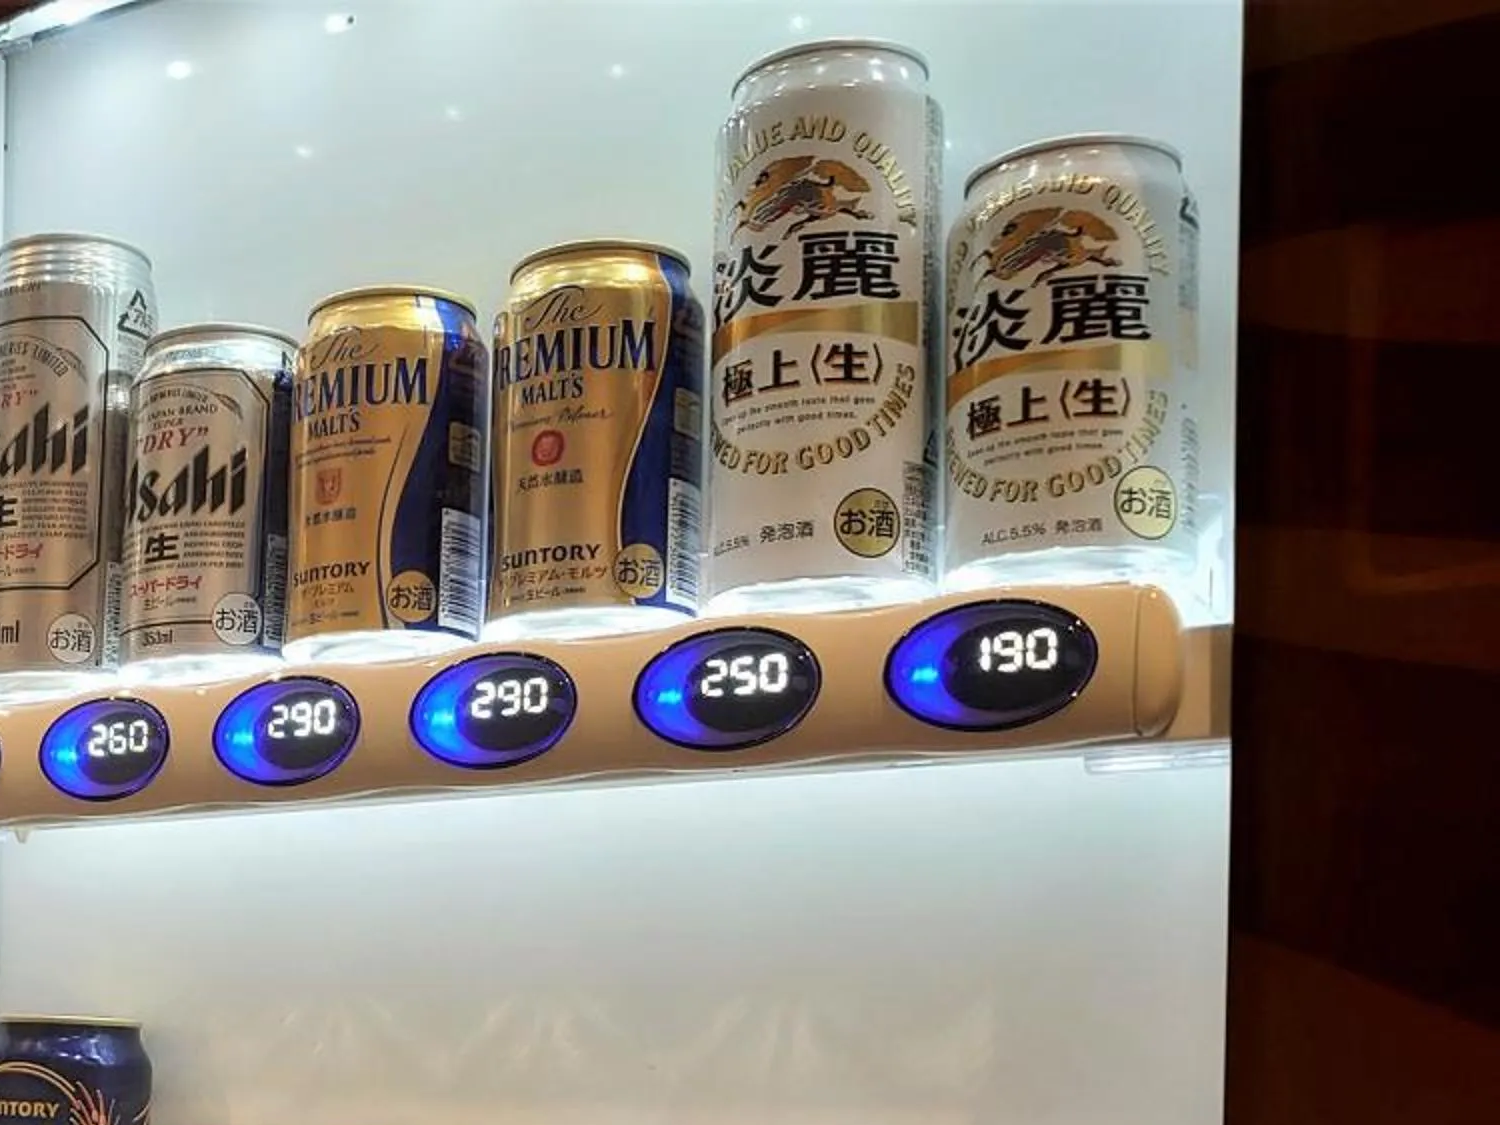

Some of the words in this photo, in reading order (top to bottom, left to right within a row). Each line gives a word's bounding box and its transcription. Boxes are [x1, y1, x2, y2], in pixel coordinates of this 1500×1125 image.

[952, 275, 1152, 370] 淡麗
[1120, 487, 1172, 519] お酒
[839, 508, 895, 539] お酒
[144, 532, 179, 564] 生
[293, 561, 371, 588] SUNTORY
[618, 558, 660, 588] お酒
[391, 585, 435, 611] お酒
[215, 608, 259, 634] お酒
[50, 627, 92, 654] お酒
[979, 627, 1058, 673] 190
[700, 653, 788, 697] 250
[471, 677, 548, 719] 290
[267, 699, 336, 739] 290
[87, 719, 149, 756] 260
